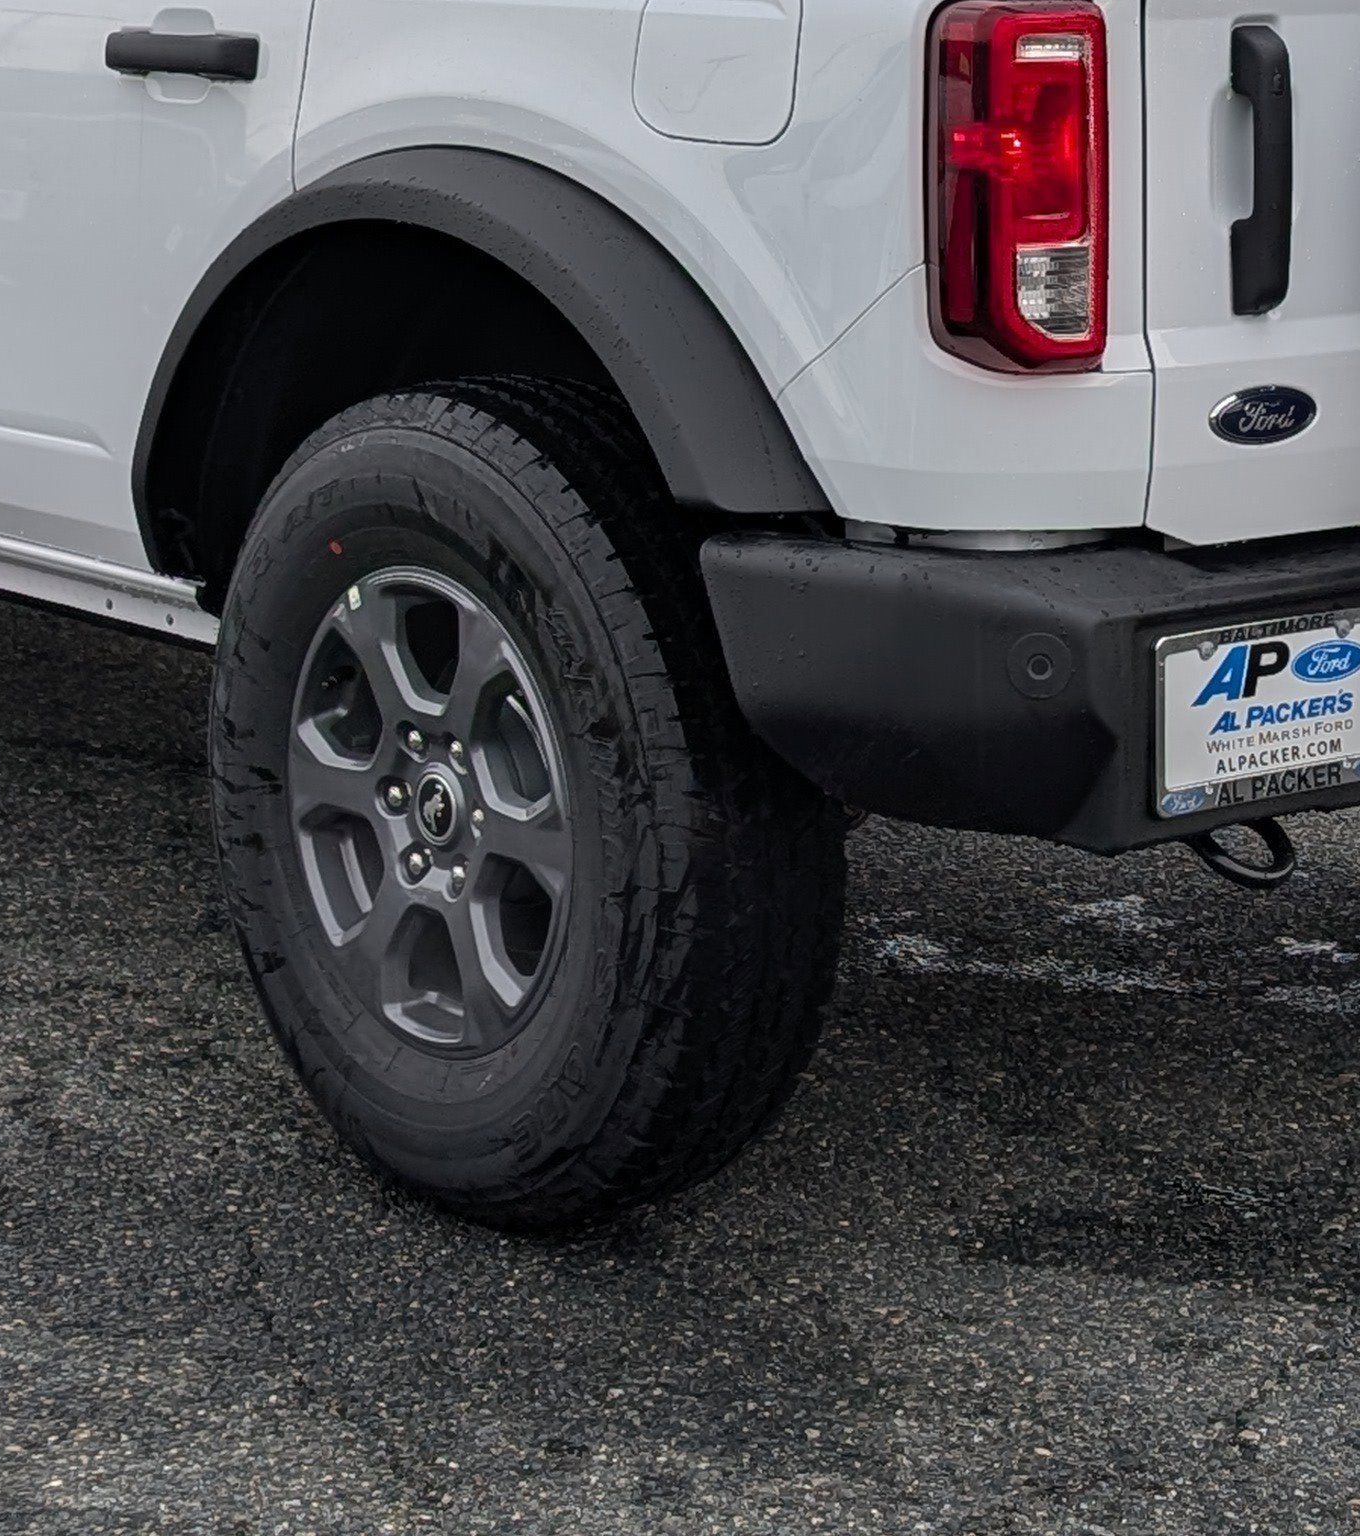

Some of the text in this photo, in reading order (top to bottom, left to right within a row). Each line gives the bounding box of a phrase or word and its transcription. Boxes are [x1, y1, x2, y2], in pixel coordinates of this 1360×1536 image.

[1238, 401, 1296, 432] Ford
[1219, 613, 1335, 643] BALTIMORE
[1190, 641, 1290, 707] AP
[1209, 710, 1242, 735] AL
[1215, 738, 1343, 775] ALPACKER.COM
[1215, 762, 1342, 806] AL PACKER
